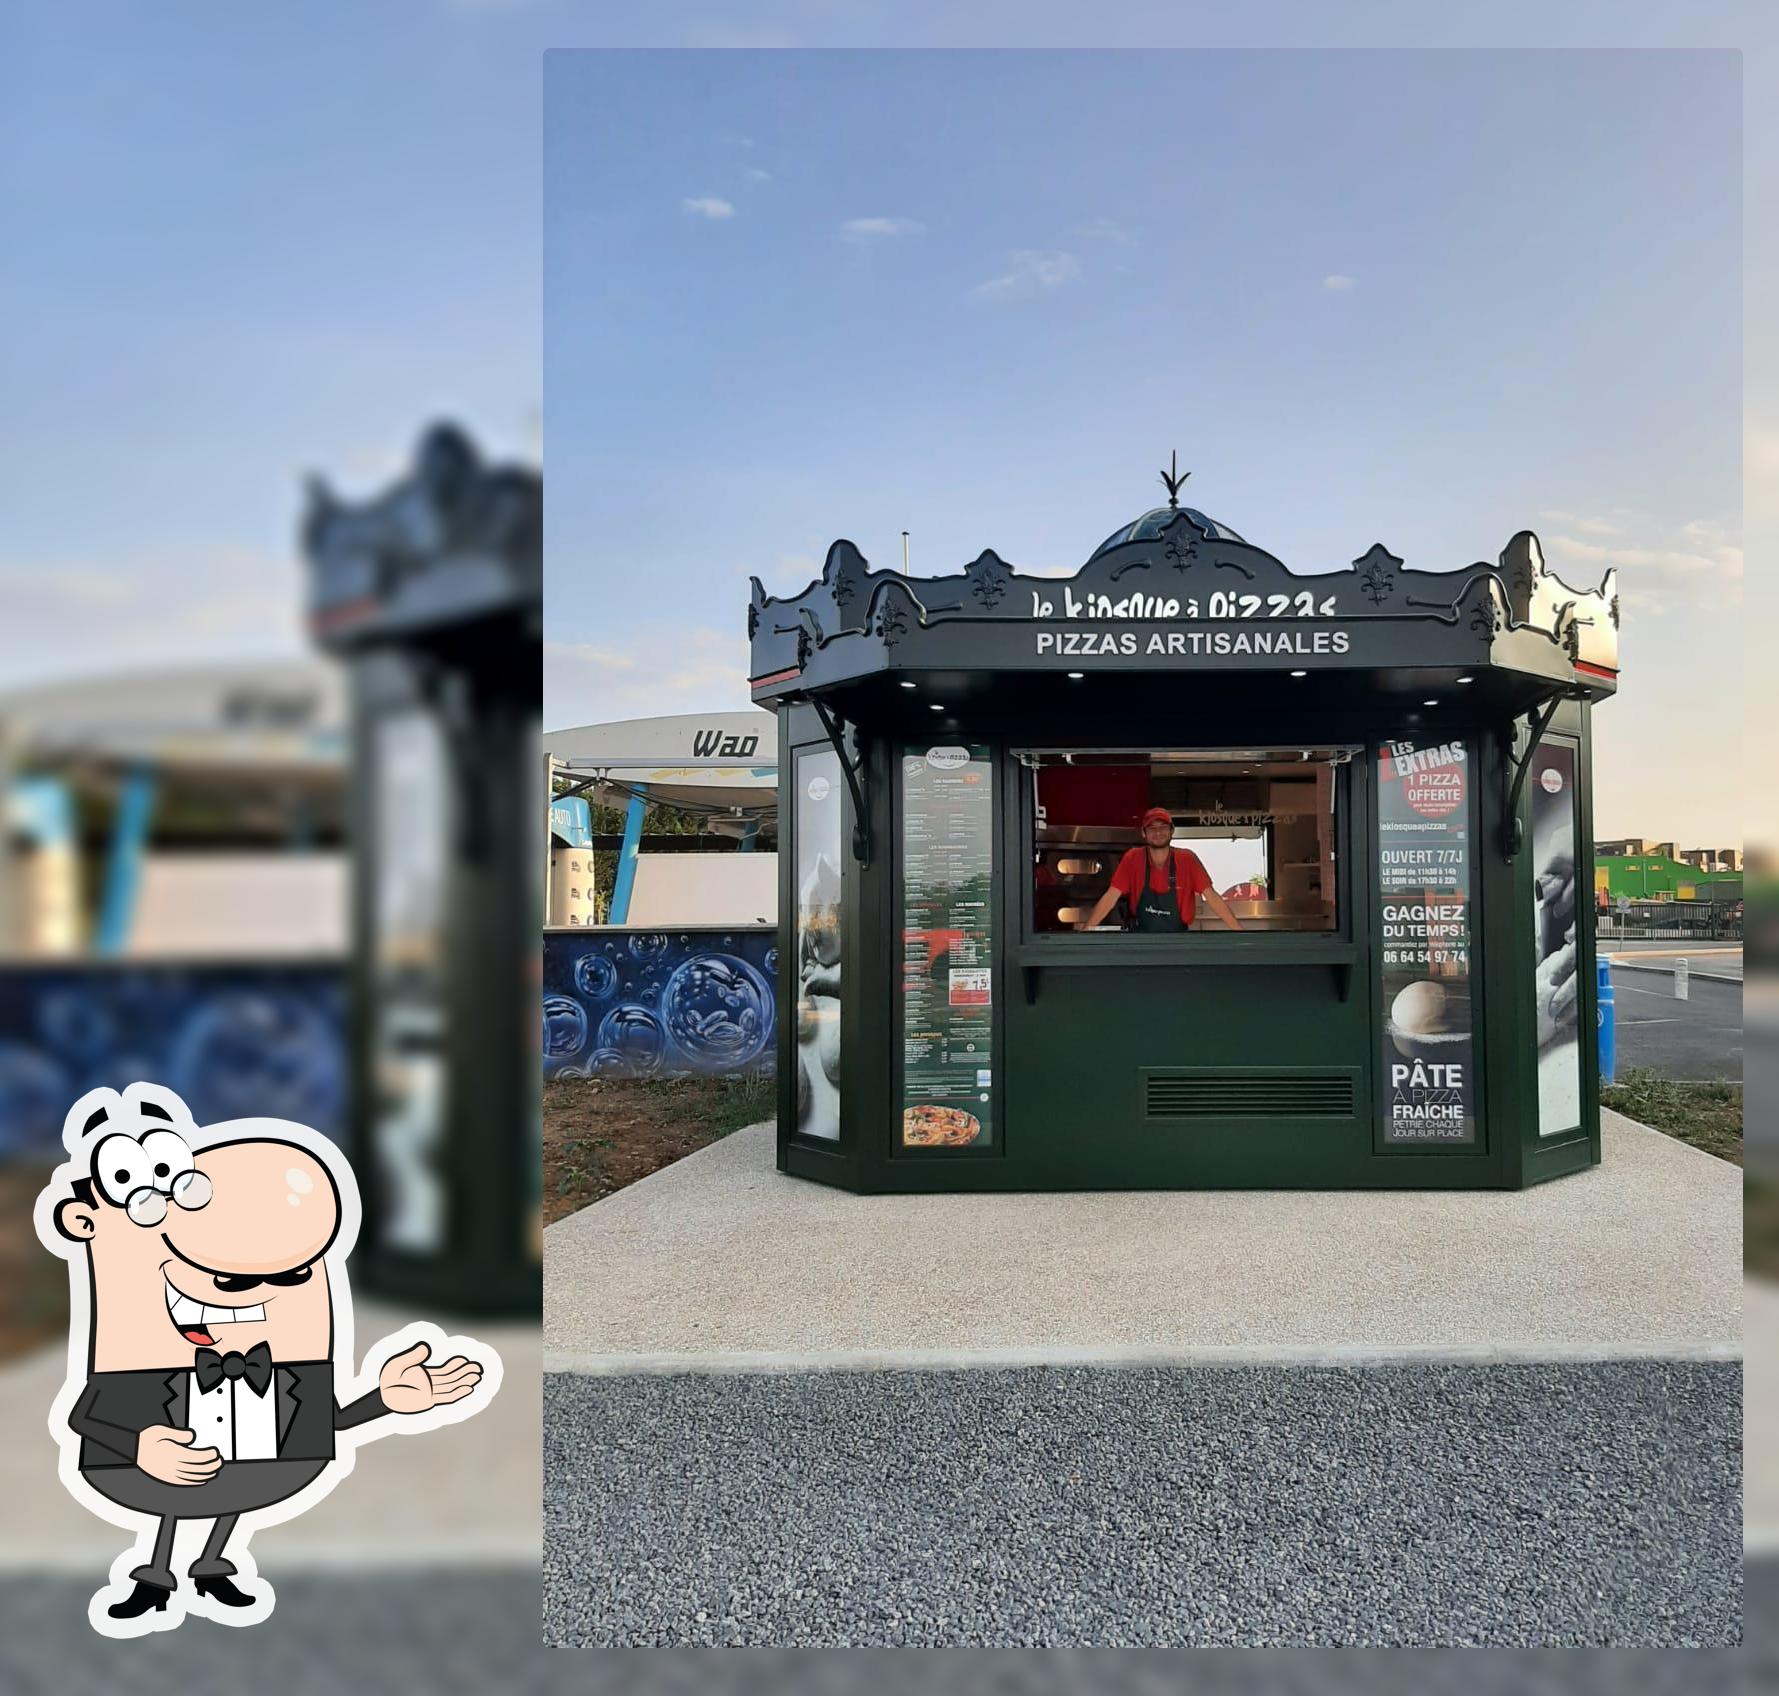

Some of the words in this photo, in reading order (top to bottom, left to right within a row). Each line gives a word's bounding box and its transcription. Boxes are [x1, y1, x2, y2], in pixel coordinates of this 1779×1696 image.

[1036, 632, 1137, 655] PIZZAS
[1145, 631, 1349, 655] ARTISANALES
[1392, 741, 1414, 756] LES
[1394, 741, 1465, 777] EXTRAS
[1409, 774, 1414, 786] 1
[1419, 773, 1461, 786] PIZZA
[1408, 788, 1461, 801] OFFERTE
[1382, 850, 1433, 864] OUVERT
[1437, 850, 1463, 864] 7/7J
[1383, 868, 1390, 876] LE
[1383, 876, 1390, 885] LE
[1382, 905, 1465, 921] GAGNEZ
[1383, 924, 1404, 937] DU
[1383, 950, 1397, 963] 06
[1400, 950, 1414, 963] 64
[1417, 950, 1431, 963] 54
[1434, 950, 1448, 963] 97
[1451, 950, 1465, 963] 74
[1391, 1058, 1463, 1088] PÂTE
[1412, 1088, 1463, 1104] PIZZA
[1392, 1102, 1464, 1119] FRAÎCHE
[1425, 1119, 1464, 1129] CHAQUE
[1392, 1128, 1416, 1137] JOUR
[1417, 1129, 1435, 1137] SUR
[1436, 1129, 1464, 1137] PLACE
